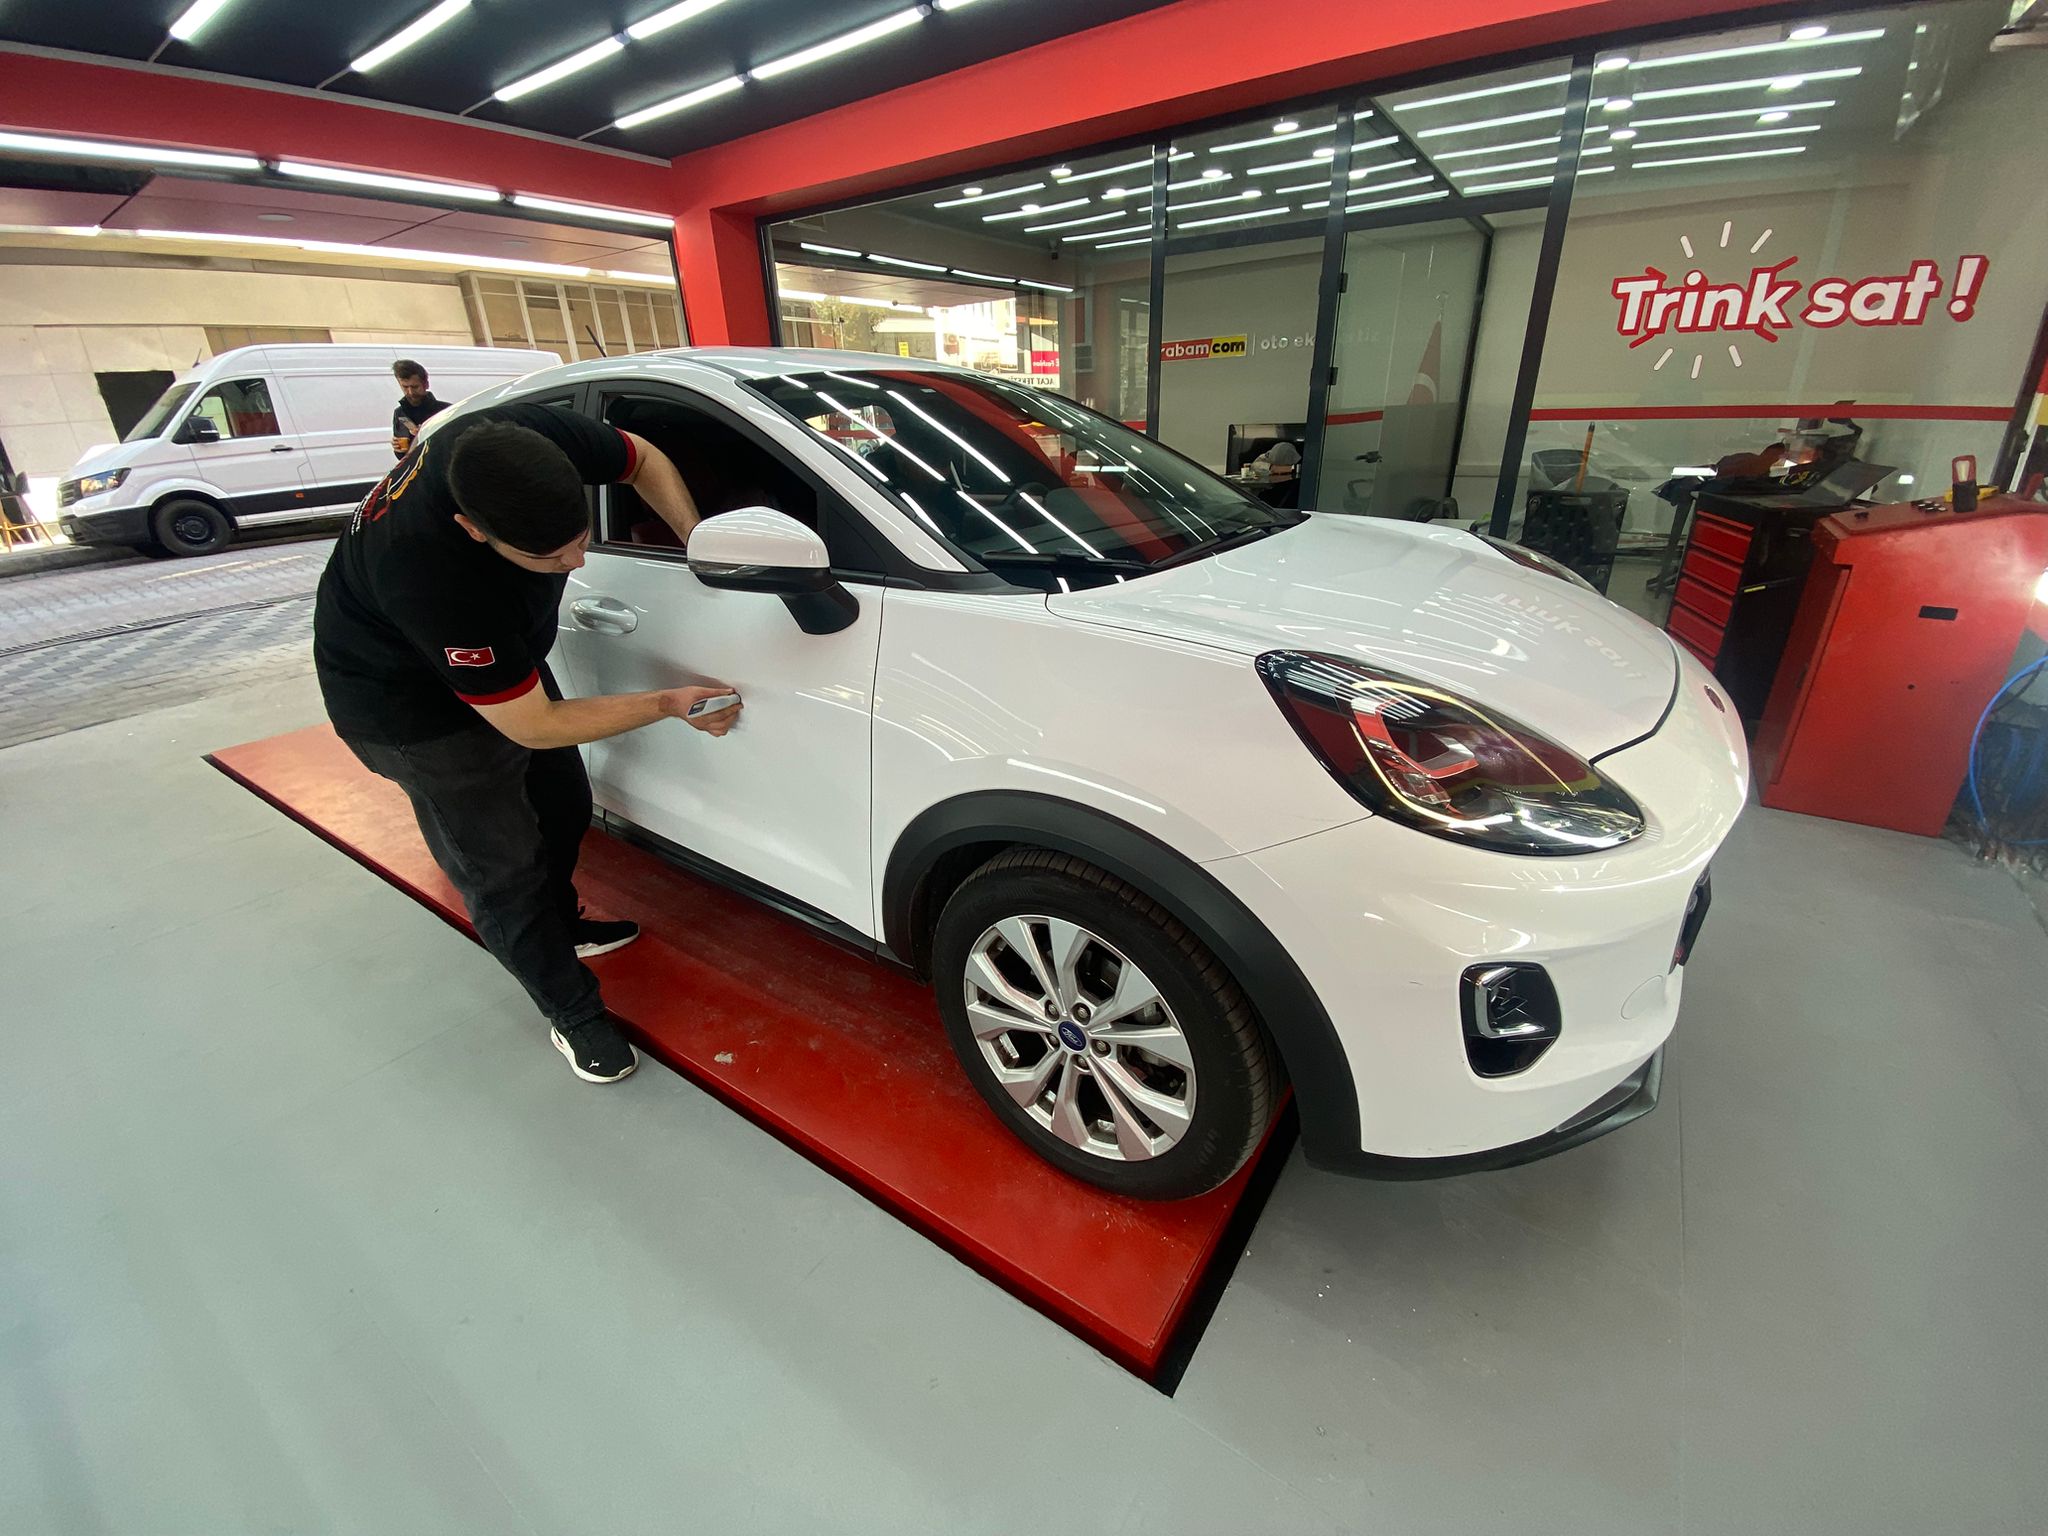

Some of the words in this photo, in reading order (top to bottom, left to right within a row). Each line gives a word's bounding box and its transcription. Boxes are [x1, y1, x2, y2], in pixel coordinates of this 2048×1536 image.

[1613, 267, 1800, 336] Trink
[1801, 260, 1941, 328] sat
[1261, 335, 1289, 350] oto
